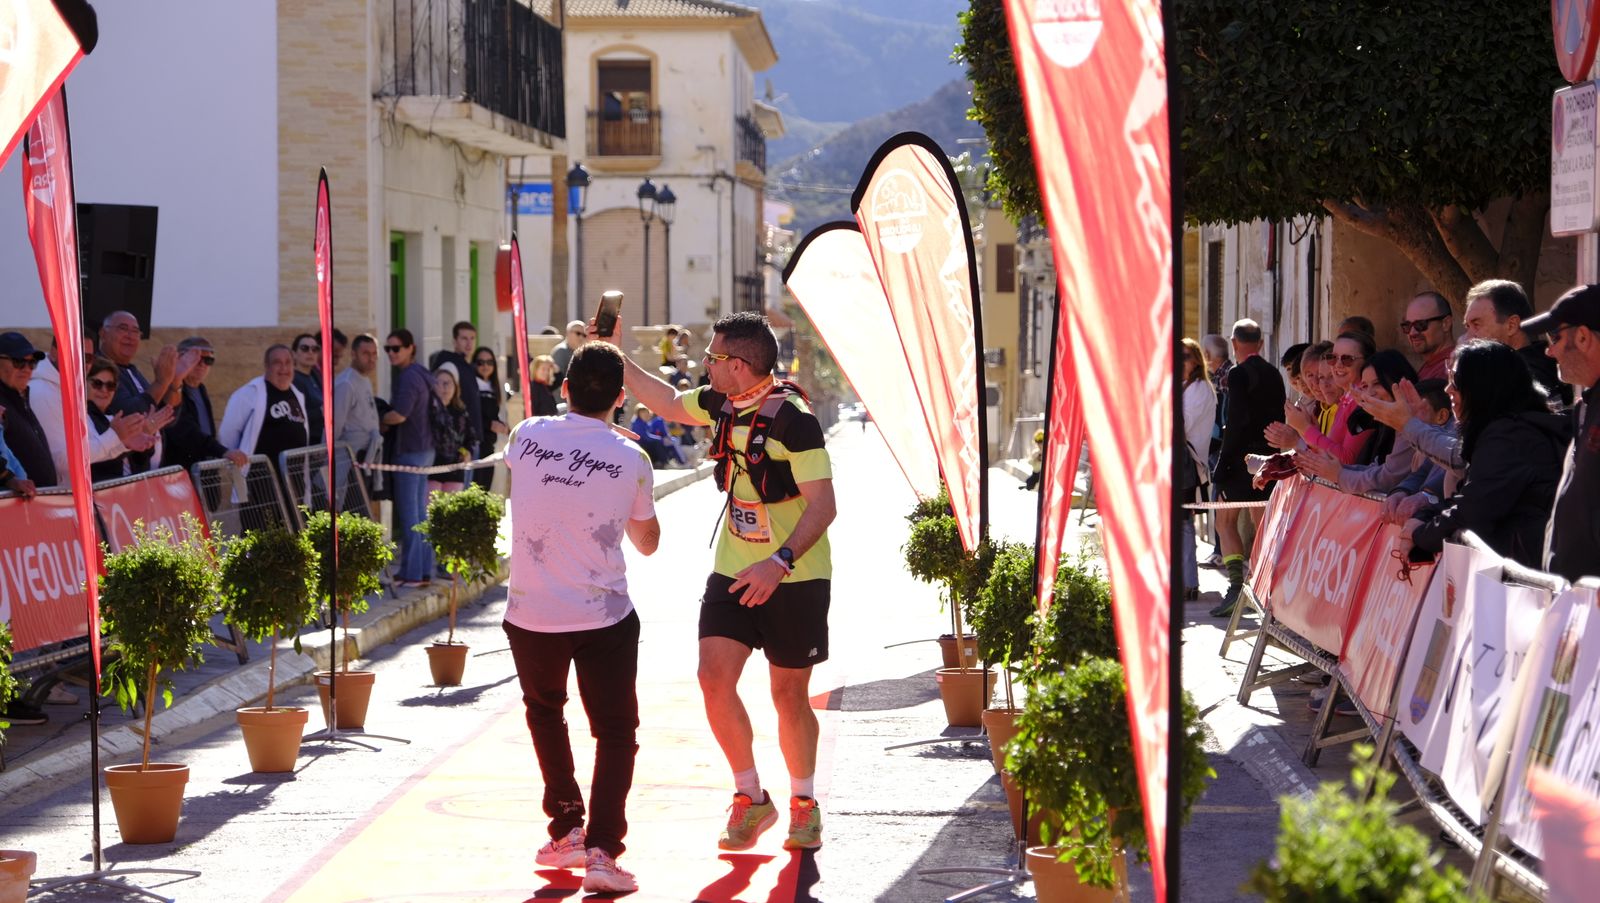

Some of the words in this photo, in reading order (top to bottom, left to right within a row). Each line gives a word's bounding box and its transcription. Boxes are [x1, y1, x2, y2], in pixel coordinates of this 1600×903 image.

[520, 438, 564, 467] Pepe
[569, 449, 623, 479] Yepes
[541, 473, 585, 488] speaker
[3, 539, 87, 605] VEOLIA
